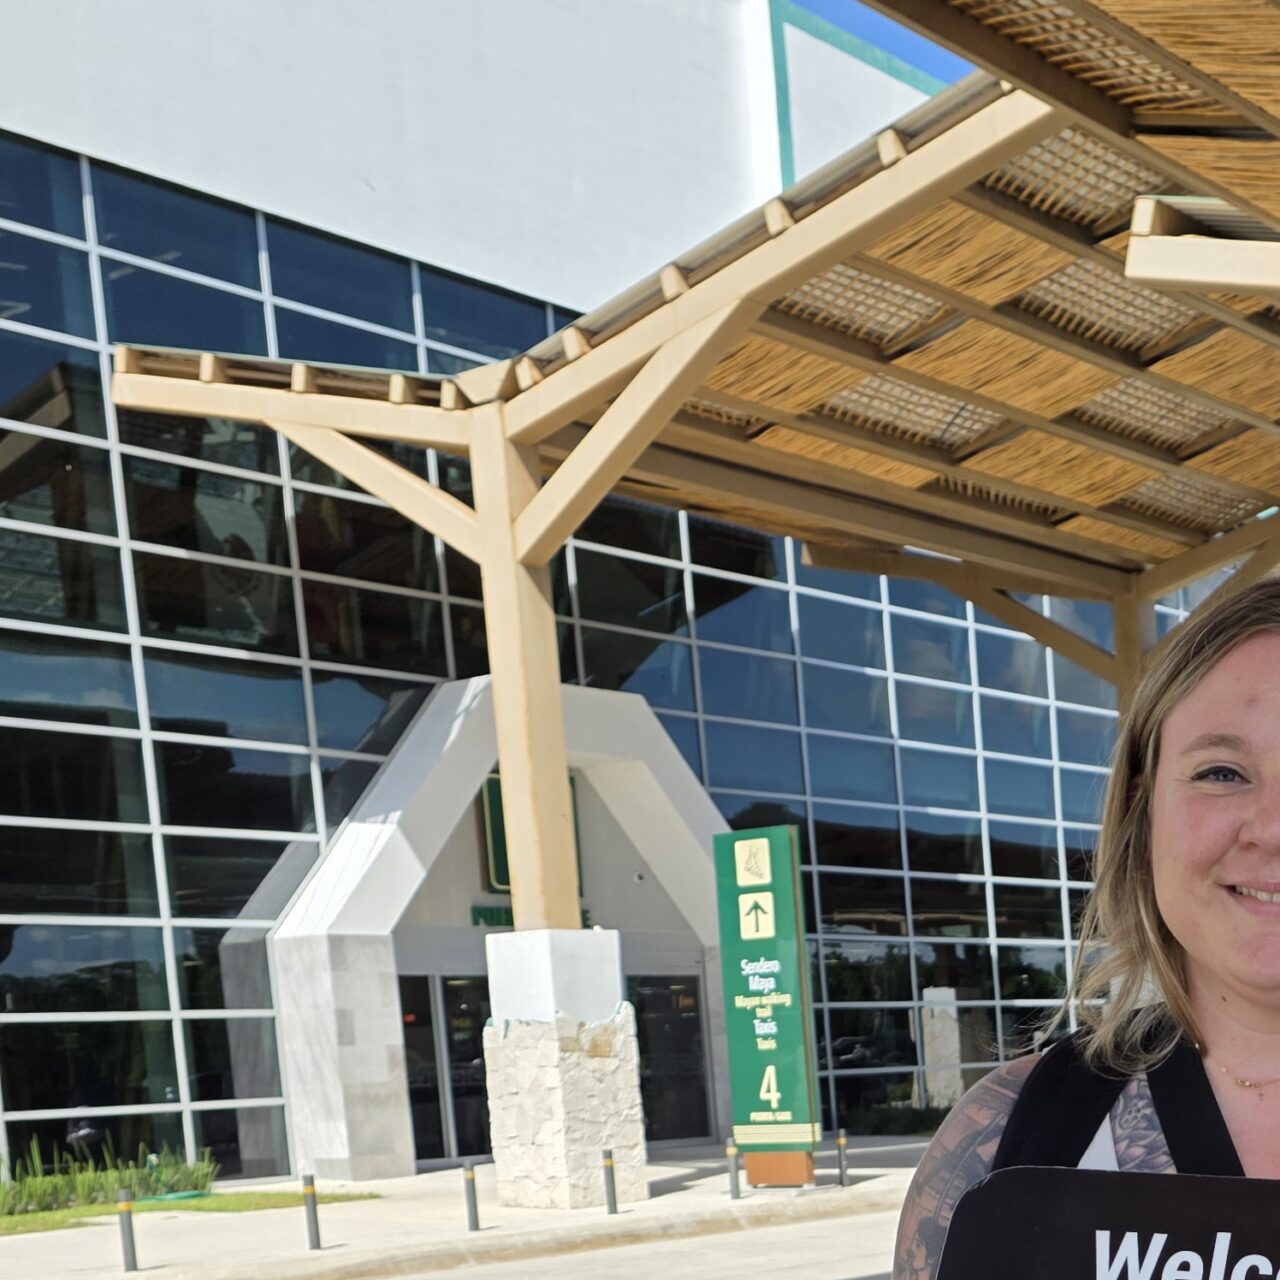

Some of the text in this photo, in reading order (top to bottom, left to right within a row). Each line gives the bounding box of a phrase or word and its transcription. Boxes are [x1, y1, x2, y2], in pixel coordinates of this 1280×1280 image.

[740, 957, 781, 976] Sendero
[748, 975, 776, 994] Maya
[759, 1065, 781, 1109] 4
